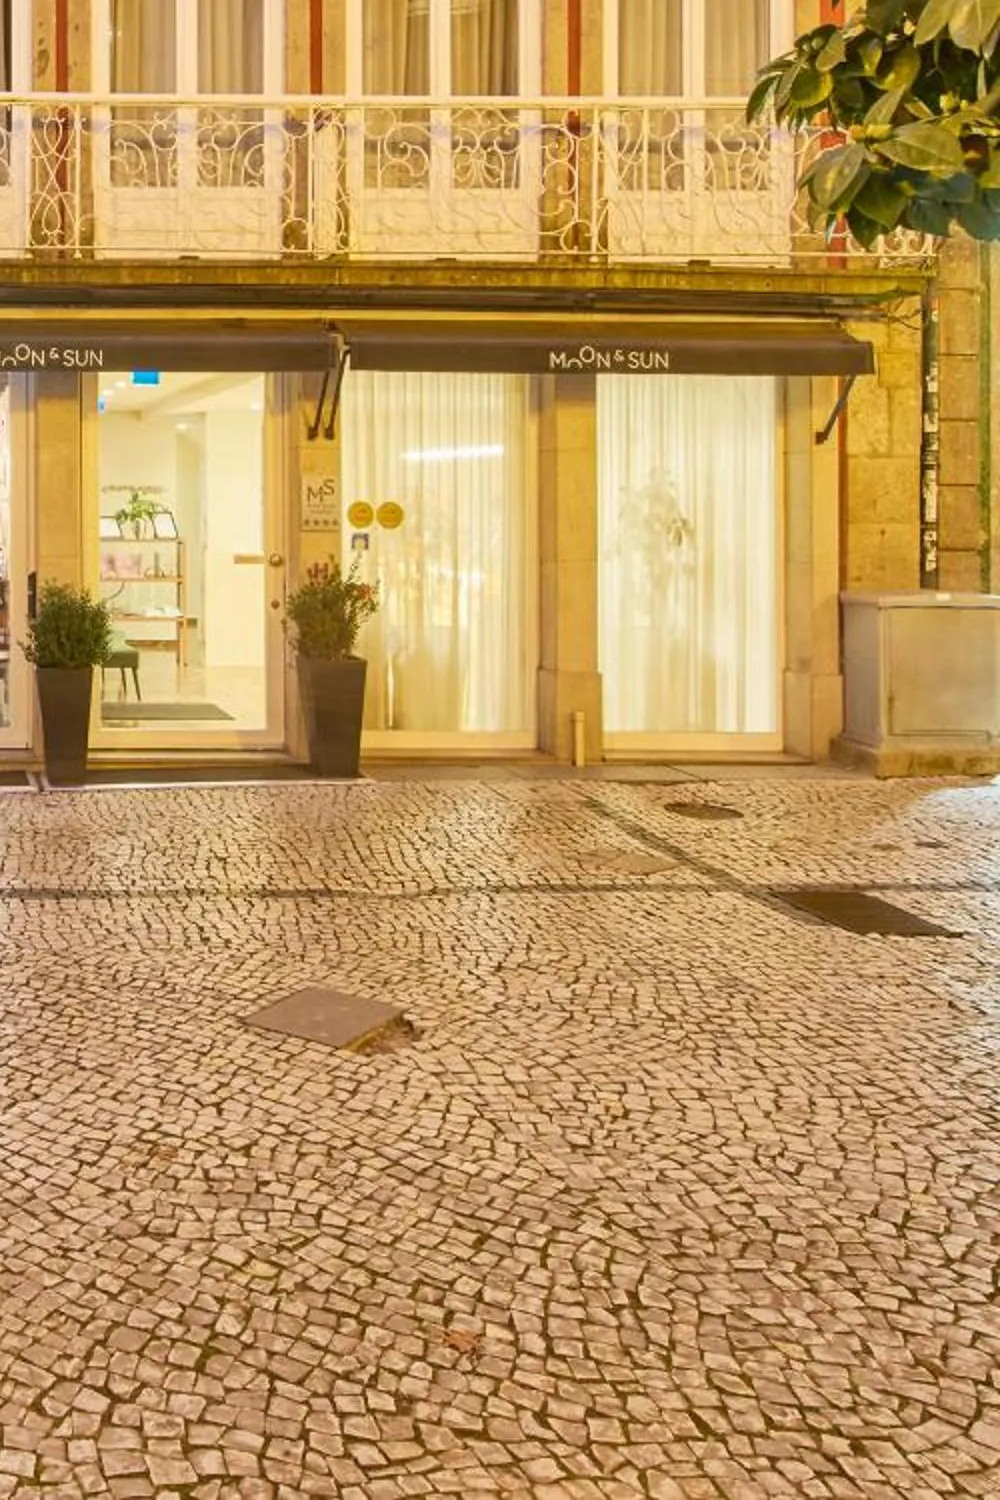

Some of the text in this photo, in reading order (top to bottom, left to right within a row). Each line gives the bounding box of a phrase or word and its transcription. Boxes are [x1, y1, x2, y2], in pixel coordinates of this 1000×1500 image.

[49, 347, 60, 359] &
[63, 348, 103, 368] SUN
[549, 345, 611, 369] MOON
[627, 350, 669, 369] SUN
